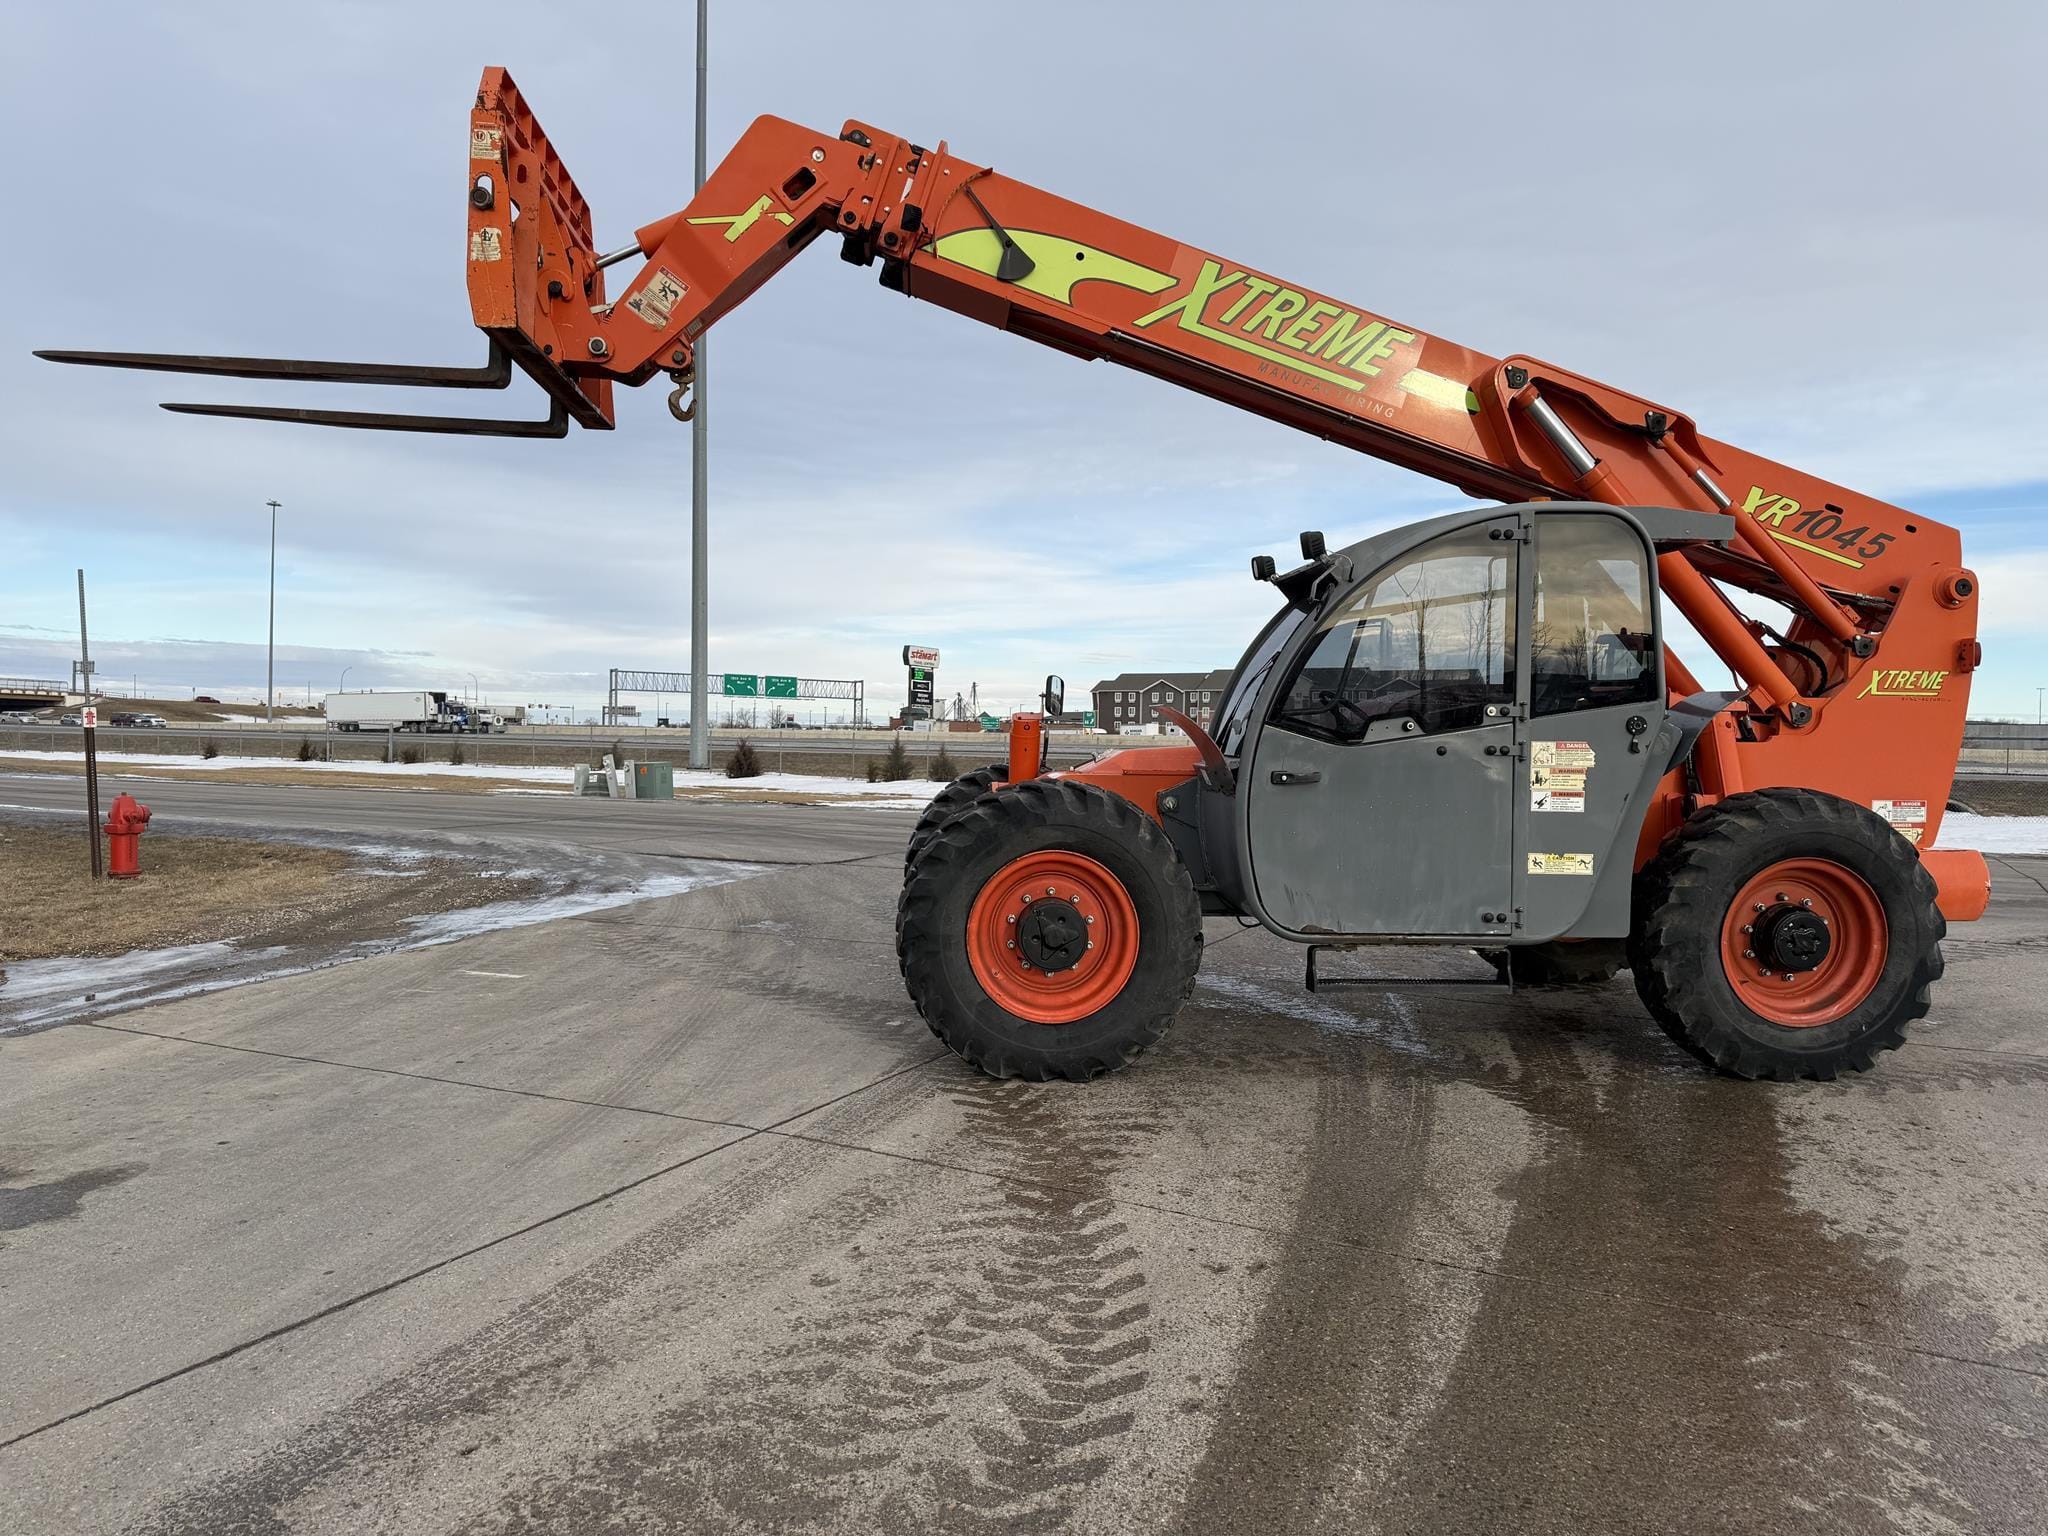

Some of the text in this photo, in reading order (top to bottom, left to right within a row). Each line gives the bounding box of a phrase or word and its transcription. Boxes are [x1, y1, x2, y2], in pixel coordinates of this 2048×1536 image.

[1132, 259, 1417, 380] XTREME
[1257, 361, 1395, 418] MANUFACTURING
[1857, 670, 1950, 700] XTREME
